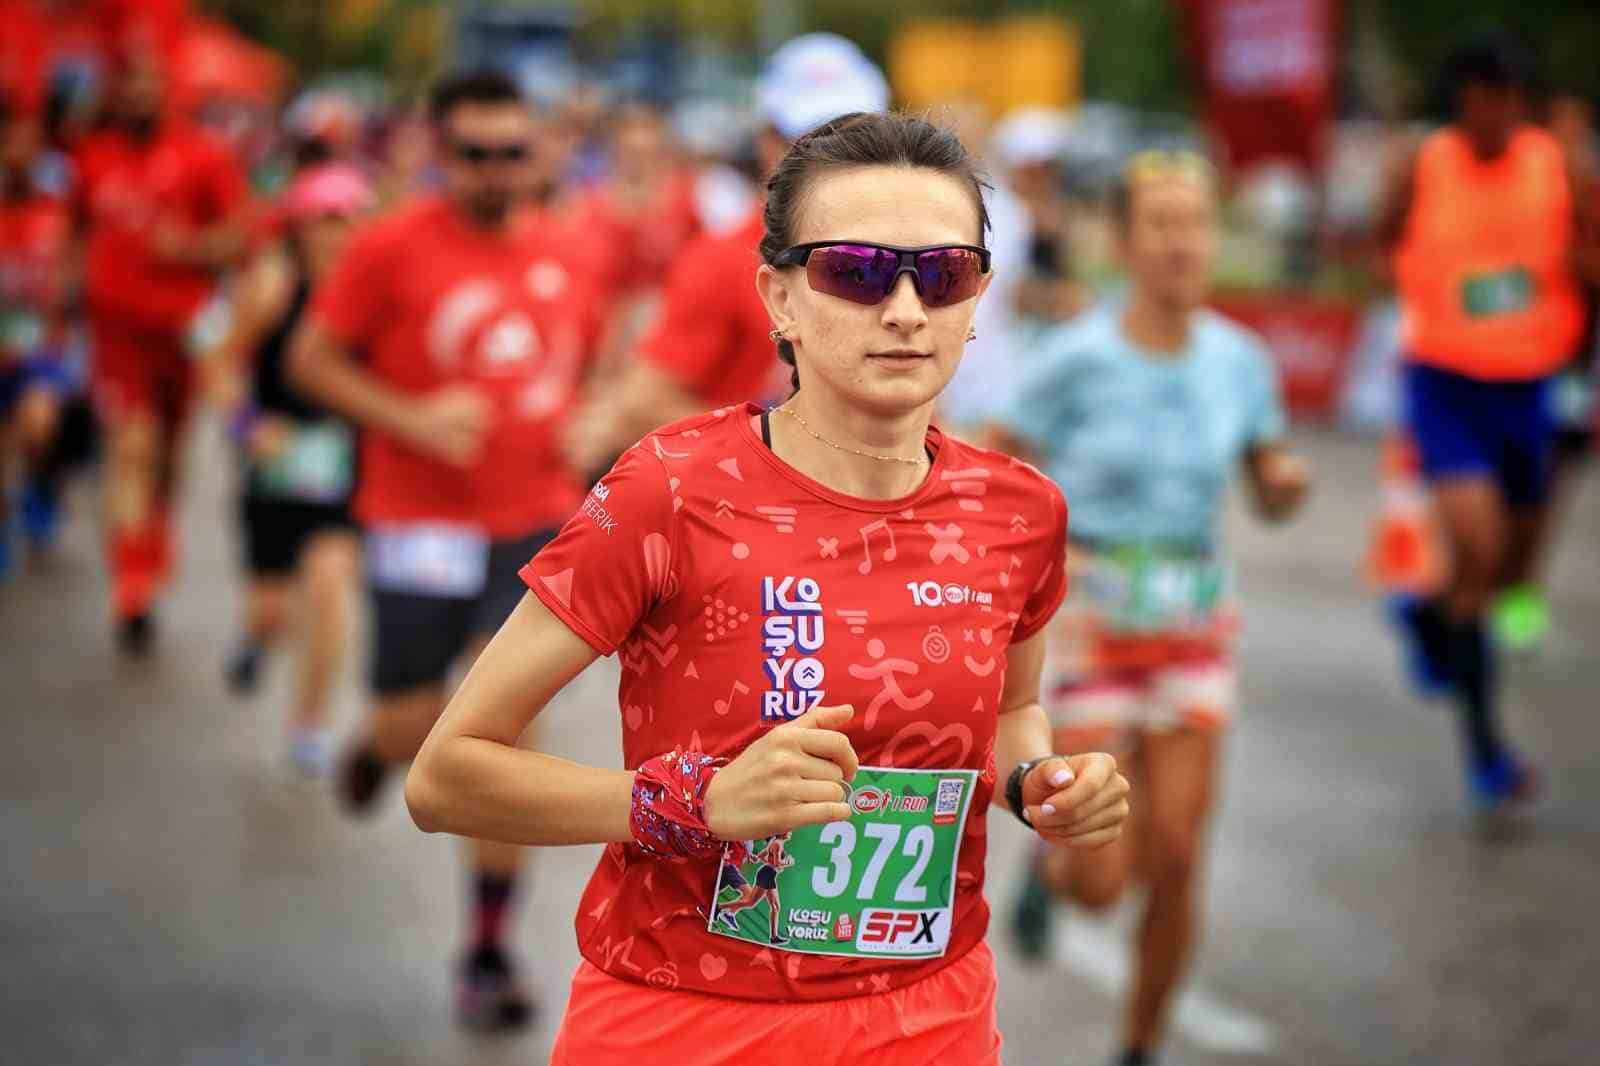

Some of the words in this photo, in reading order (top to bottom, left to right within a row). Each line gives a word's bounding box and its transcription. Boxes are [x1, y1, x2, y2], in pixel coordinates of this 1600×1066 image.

[764, 615, 825, 657] ŞU
[900, 795, 928, 813] RUN
[811, 820, 935, 903] 372
[787, 925, 829, 941] YORUZ
[861, 911, 940, 945] SPX
